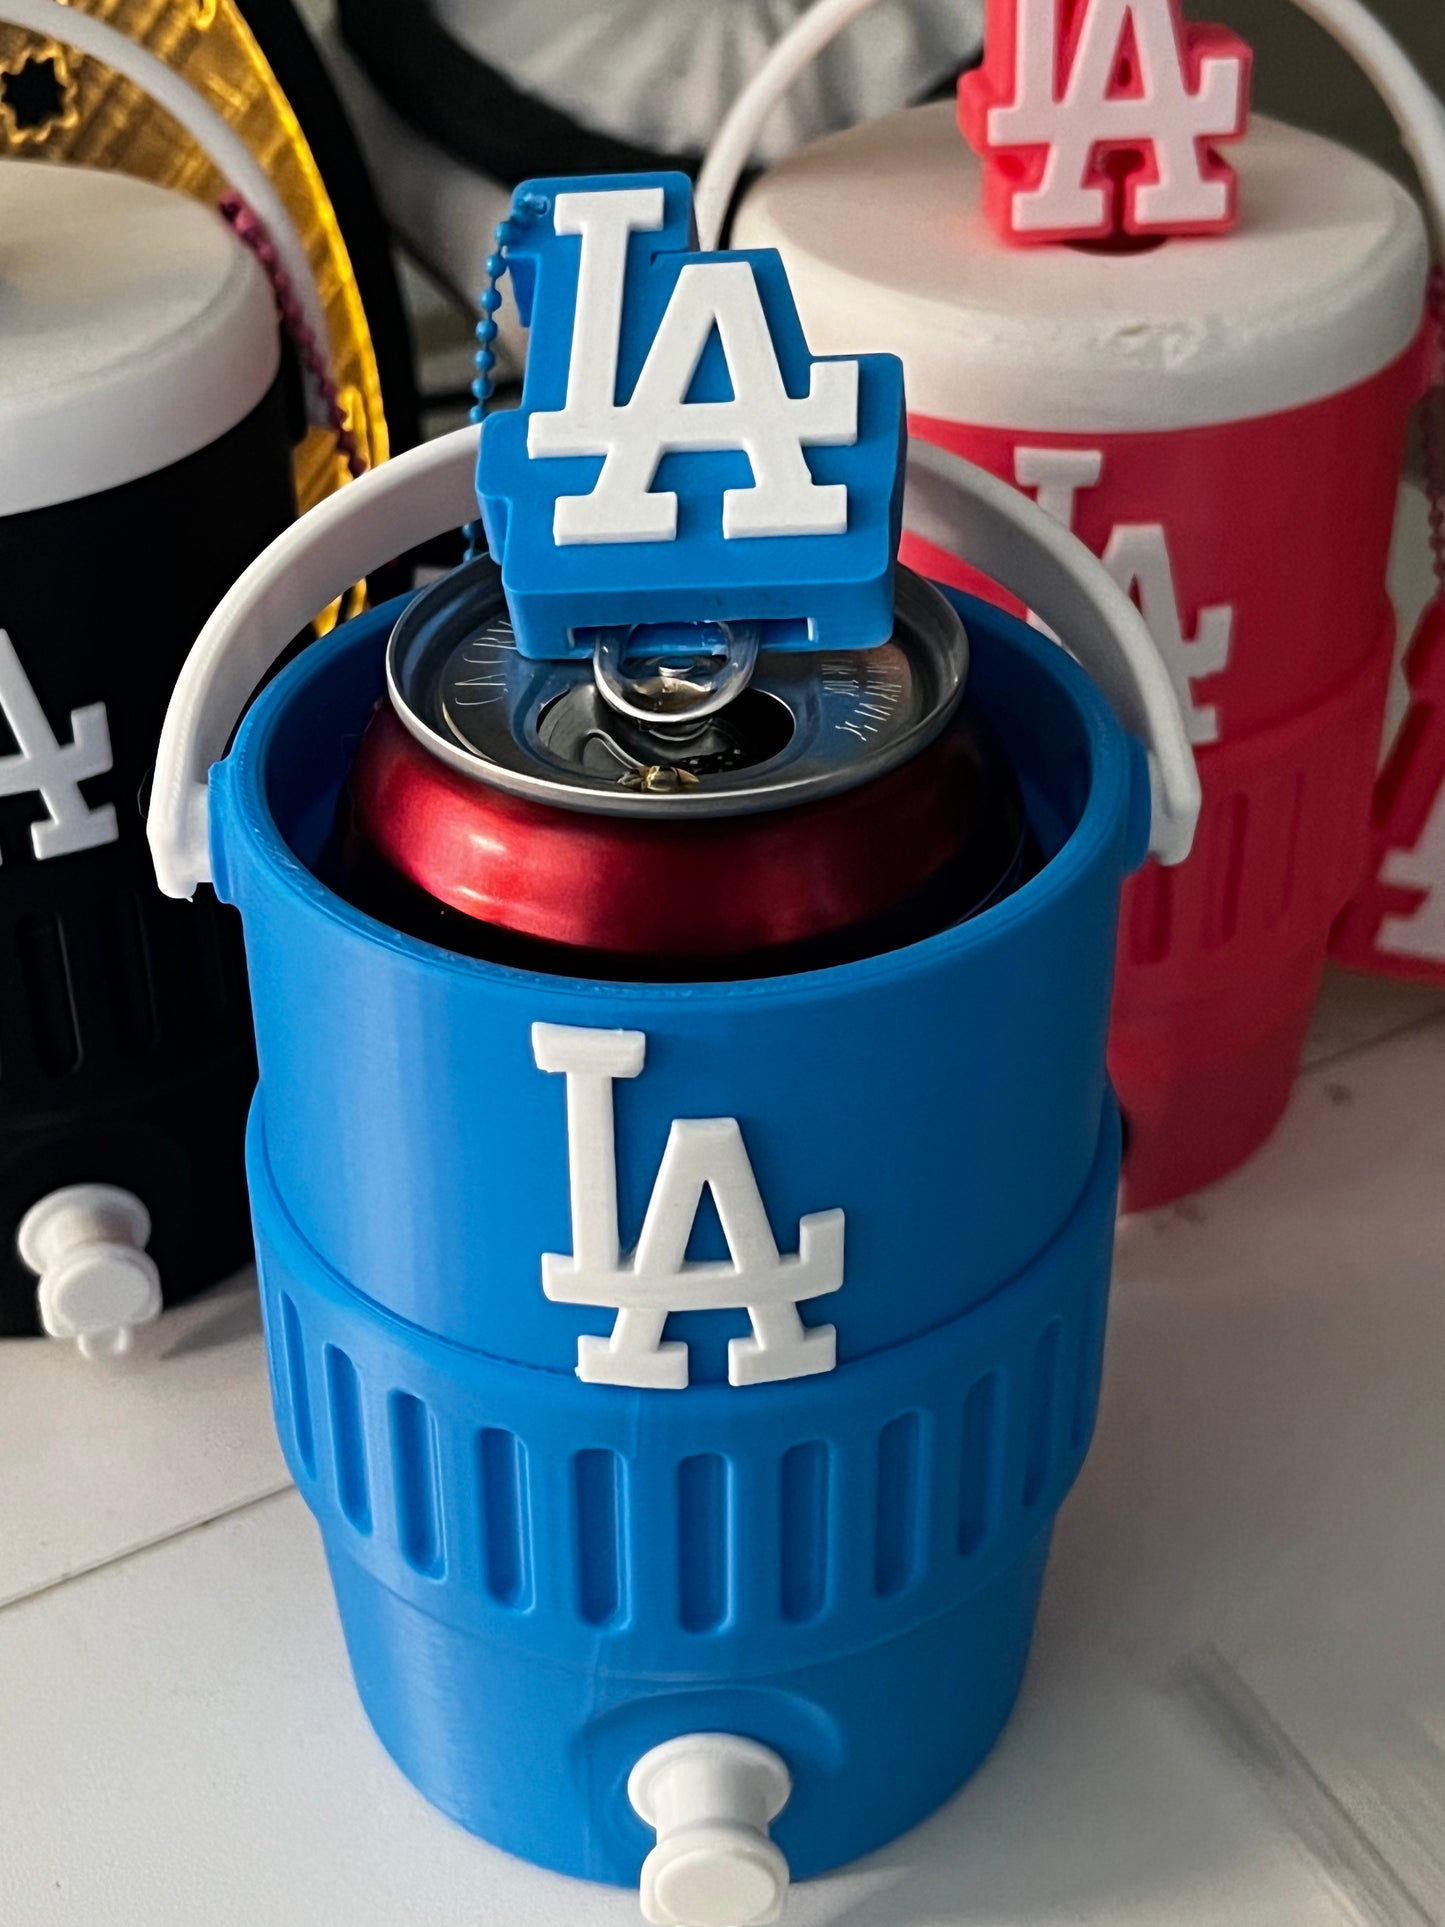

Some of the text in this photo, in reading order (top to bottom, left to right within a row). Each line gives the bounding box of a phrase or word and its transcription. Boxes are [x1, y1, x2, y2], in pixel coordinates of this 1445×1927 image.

[987, 0, 1240, 231] LA
[527, 187, 859, 547] LA
[531, 1021, 846, 1390] LA
